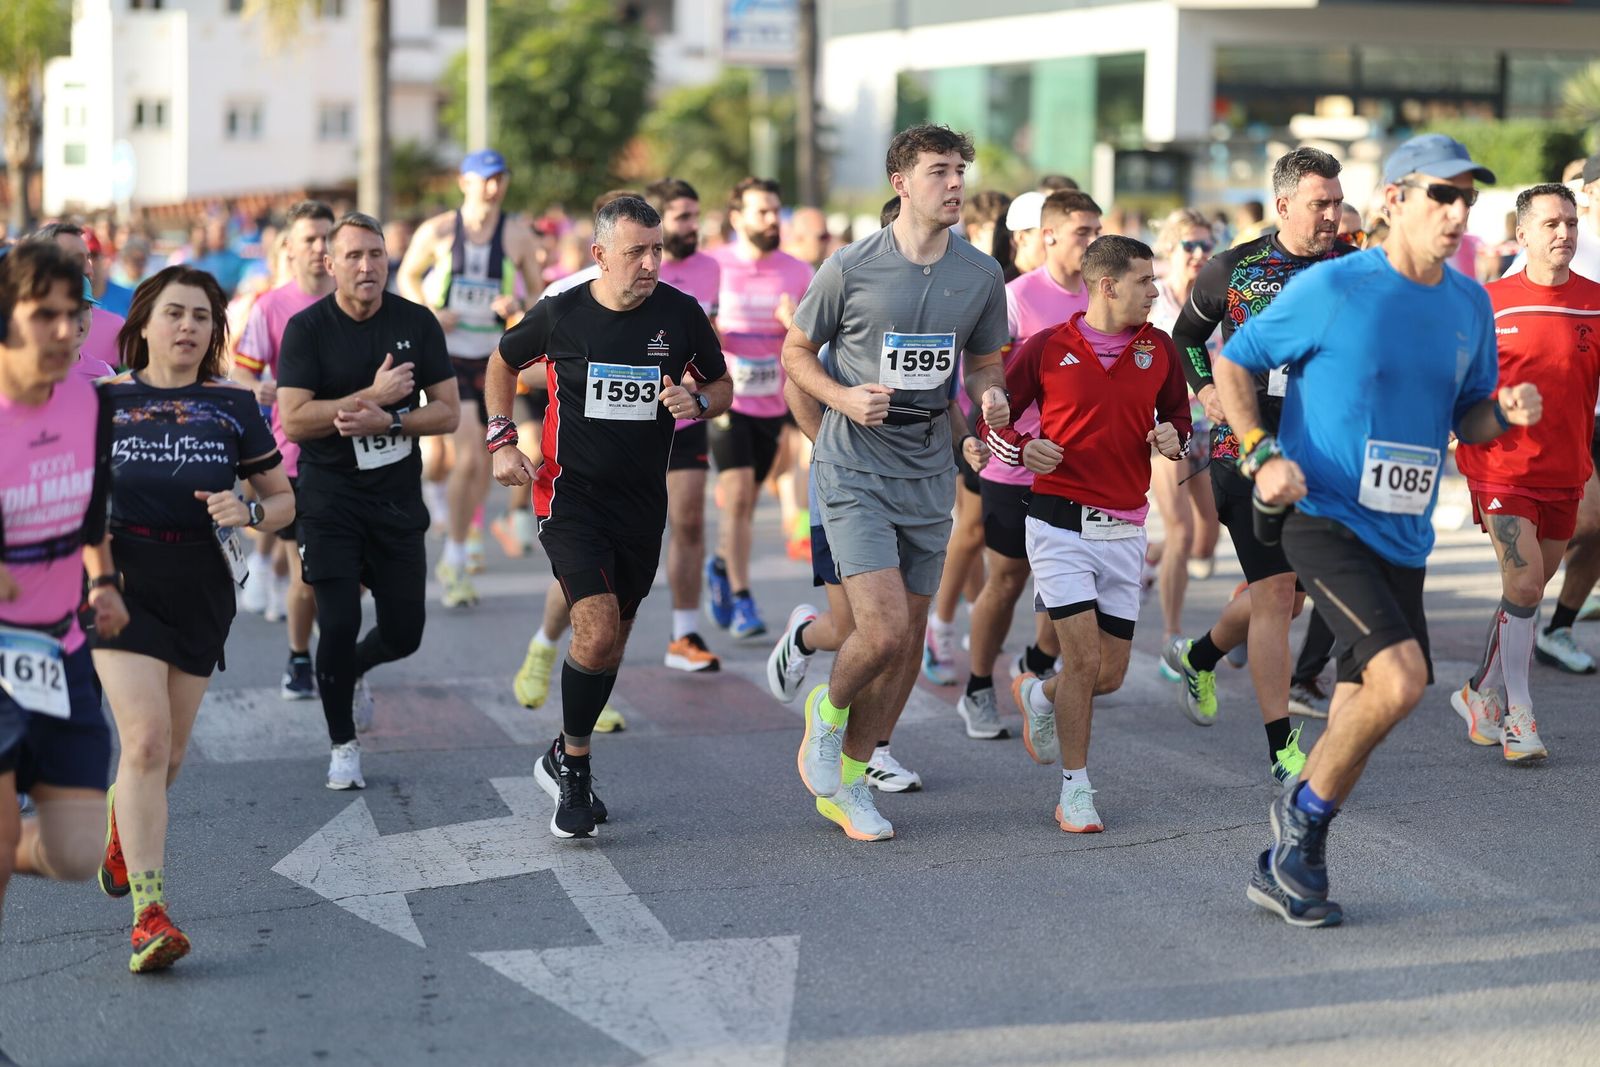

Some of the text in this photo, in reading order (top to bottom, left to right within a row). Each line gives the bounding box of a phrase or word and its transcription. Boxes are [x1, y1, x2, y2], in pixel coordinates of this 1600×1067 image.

[887, 350, 951, 371] 1595
[592, 380, 656, 403] 1593
[1372, 463, 1433, 493] 1085
